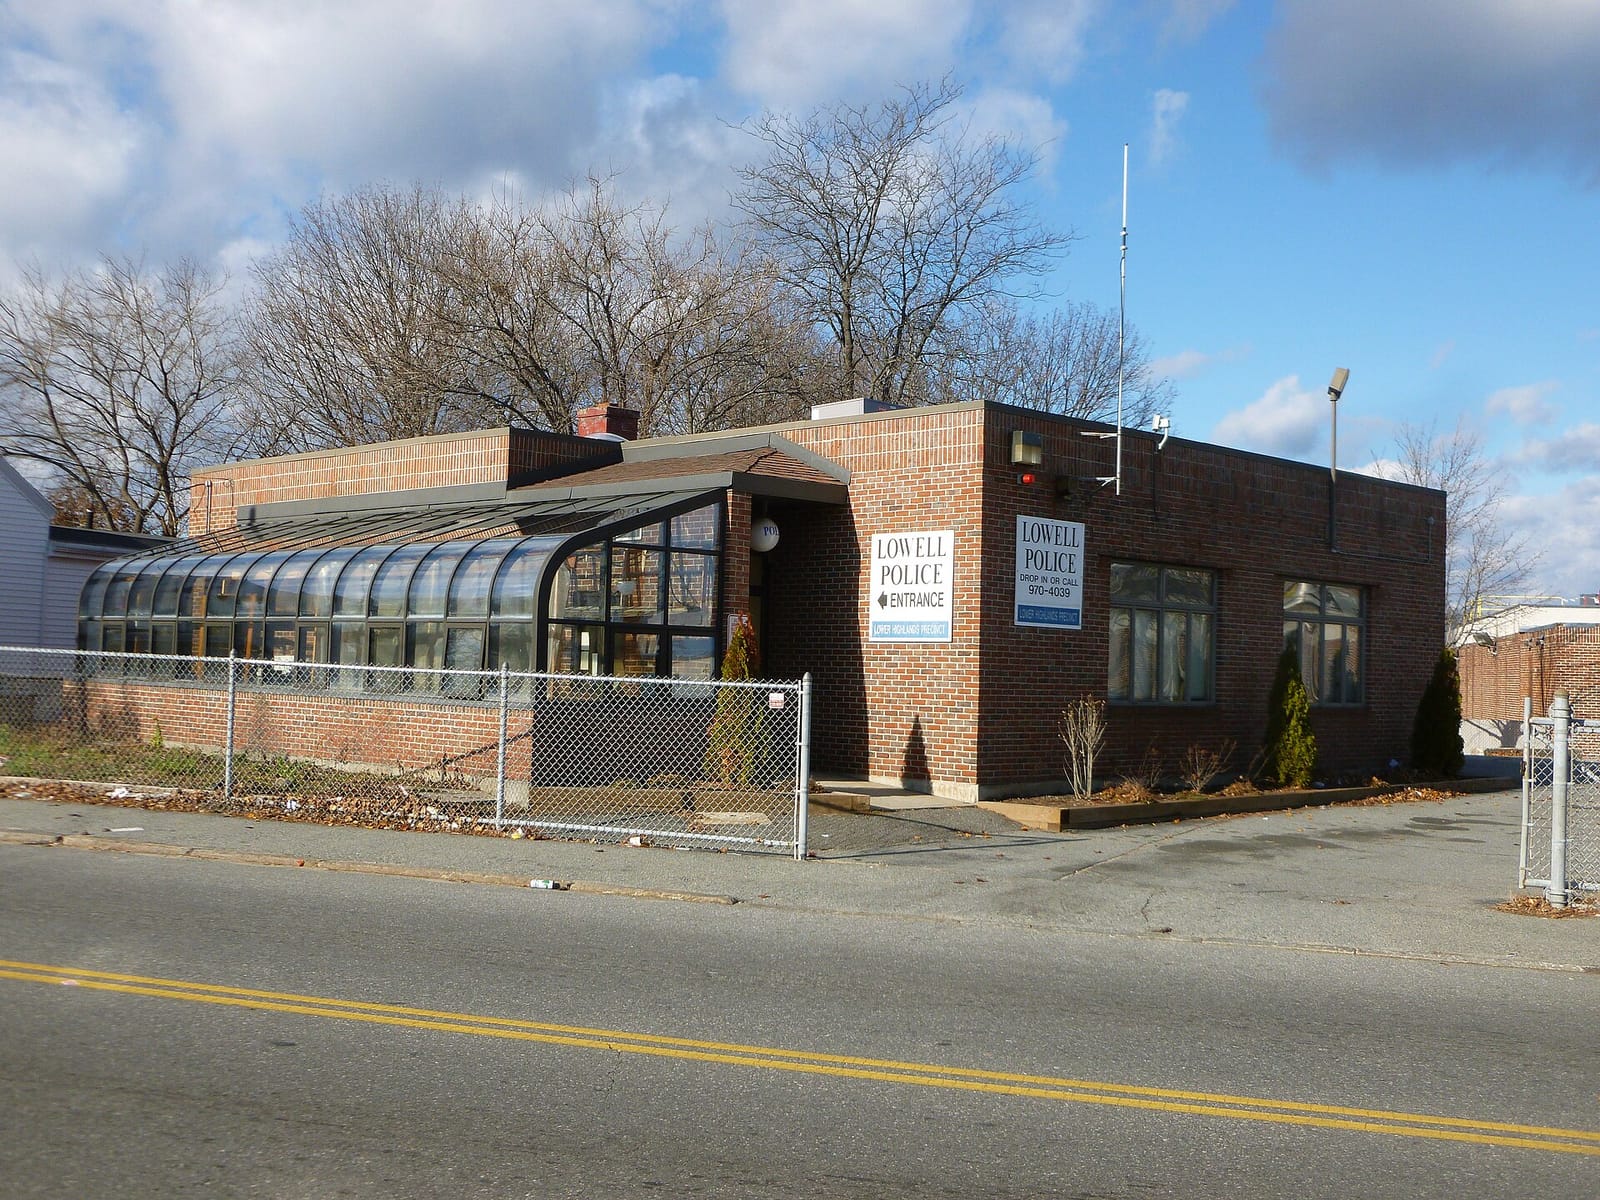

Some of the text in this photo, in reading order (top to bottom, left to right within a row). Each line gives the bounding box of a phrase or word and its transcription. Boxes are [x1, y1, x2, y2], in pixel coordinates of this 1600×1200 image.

[1022, 521, 1079, 548] LOWELL
[878, 536, 946, 559] LOWELL
[1025, 548, 1076, 574] POLICE
[881, 563, 943, 586] POLICE
[1020, 573, 1079, 587] DROP IN OR CALL
[890, 591, 944, 608] ENTRANCE
[1028, 584, 1071, 598] 970-4039
[874, 623, 945, 635] LOWER HIGHLANDS PRECINCT
